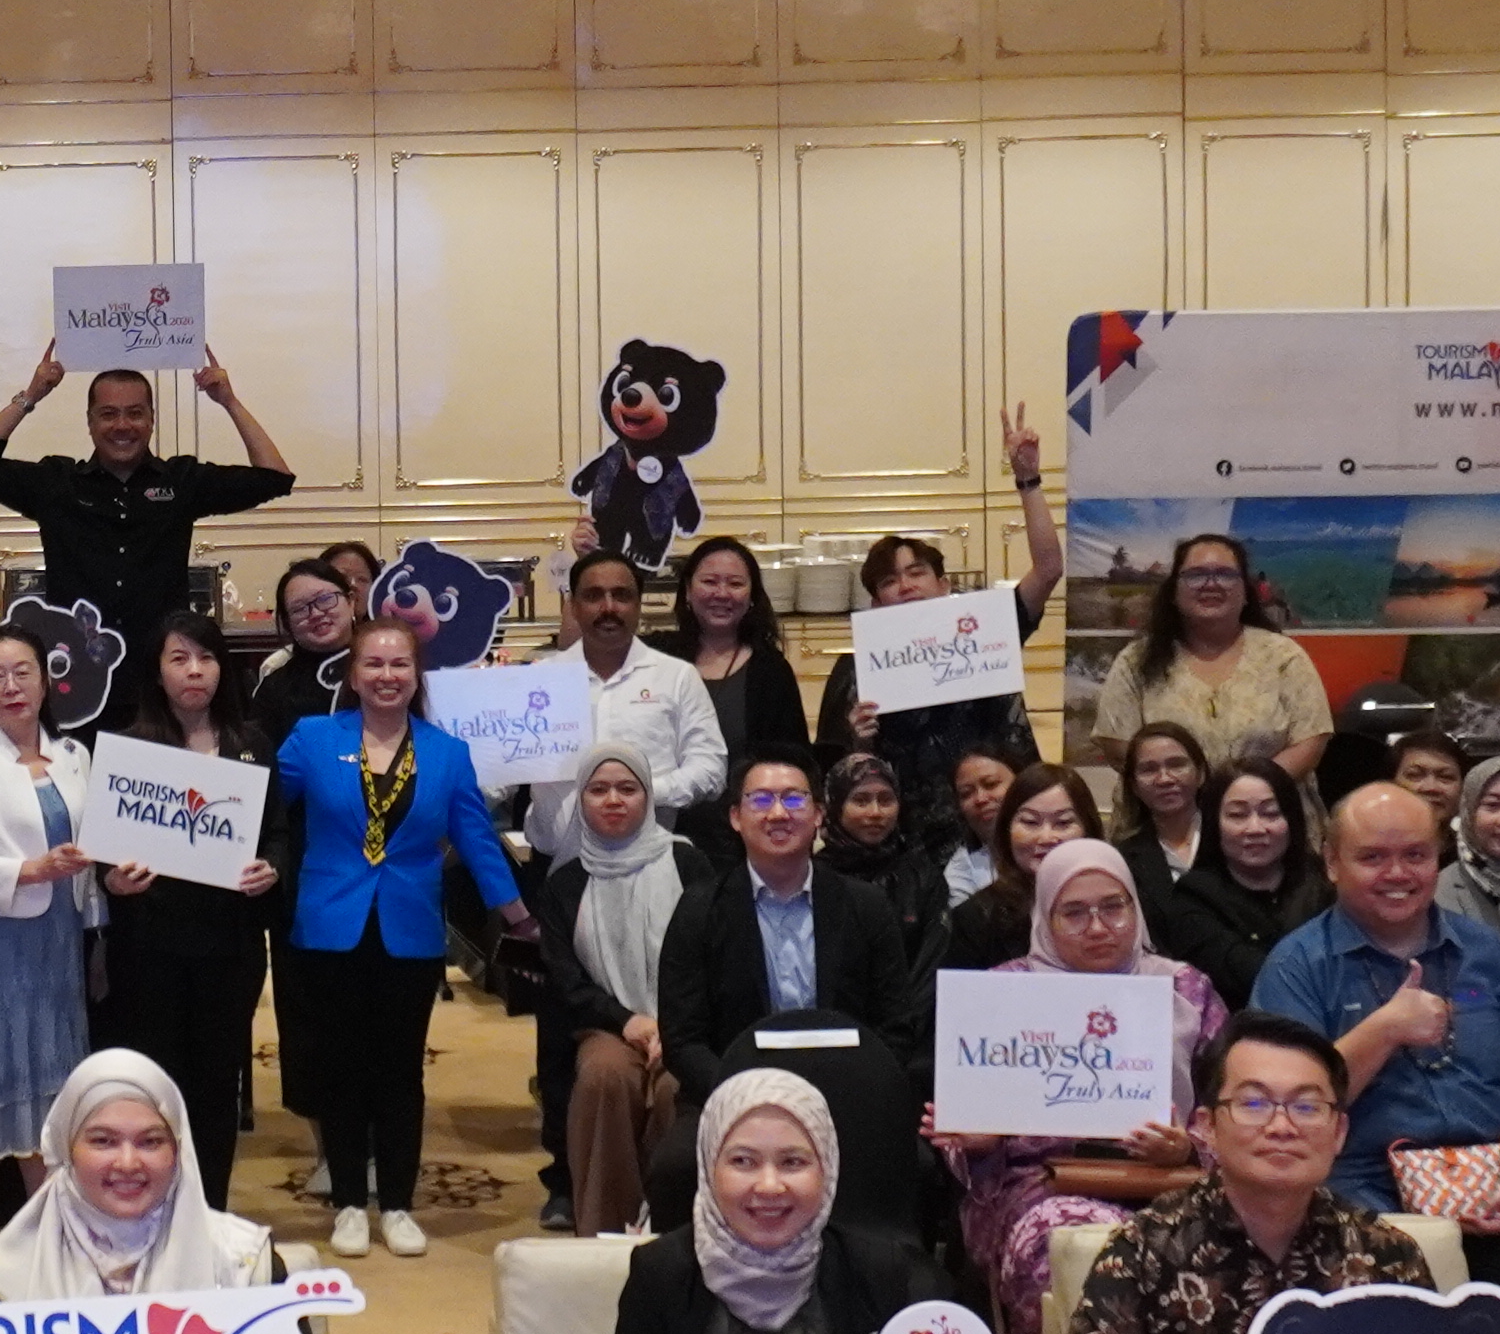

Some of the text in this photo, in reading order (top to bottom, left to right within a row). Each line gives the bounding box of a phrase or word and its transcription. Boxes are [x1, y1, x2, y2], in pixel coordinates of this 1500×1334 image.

[68, 304, 168, 332] Malaysia
[125, 329, 193, 352] Truly Asia
[1416, 344, 1489, 359] TOURISM
[870, 637, 978, 671] Malaysia
[108, 774, 186, 806] TOURISM
[117, 797, 232, 846] MALAYSIA
[959, 1034, 1113, 1075] Malaysia
[1044, 1073, 1151, 1107] Truly Asia
